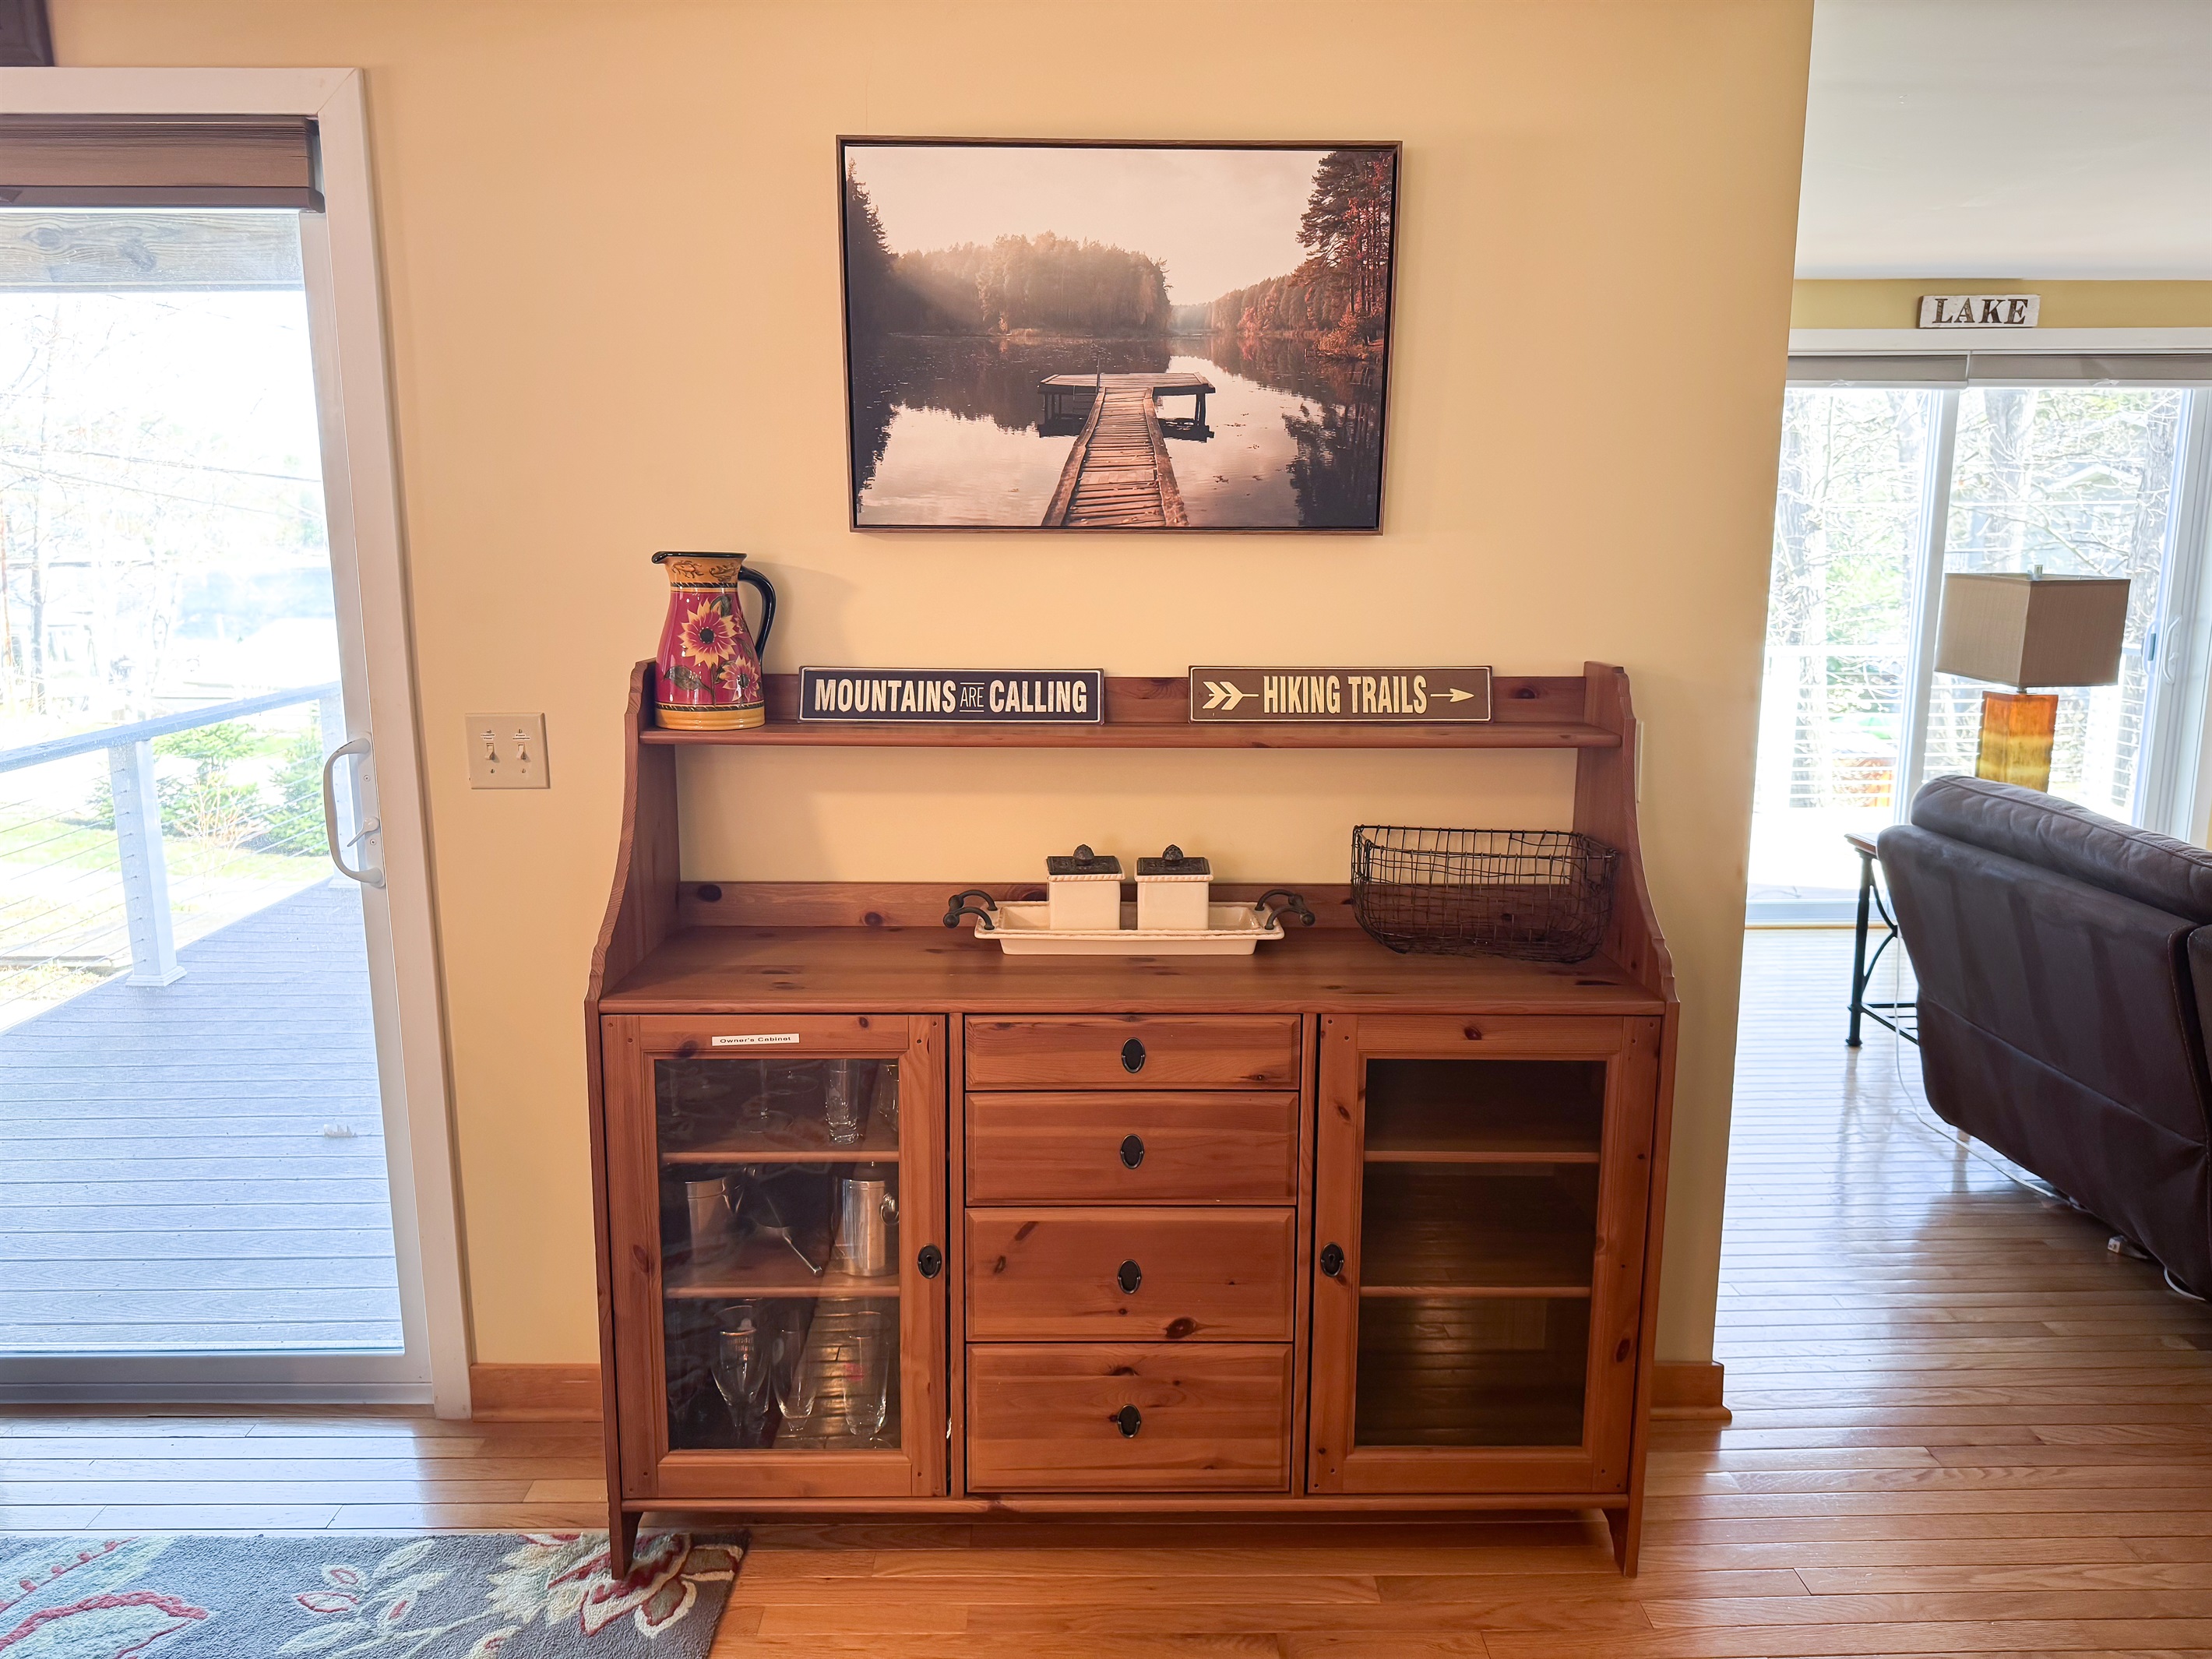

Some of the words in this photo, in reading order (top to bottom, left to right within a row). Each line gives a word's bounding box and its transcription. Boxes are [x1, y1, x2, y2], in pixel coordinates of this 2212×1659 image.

[1932, 298, 2029, 324] LAKE
[815, 678, 956, 713] MOUNTAINS
[960, 686, 984, 708] ARE
[989, 680, 1087, 713] CALLING
[1263, 675, 1340, 714] HIKING
[1347, 675, 1427, 714] TRAILS
